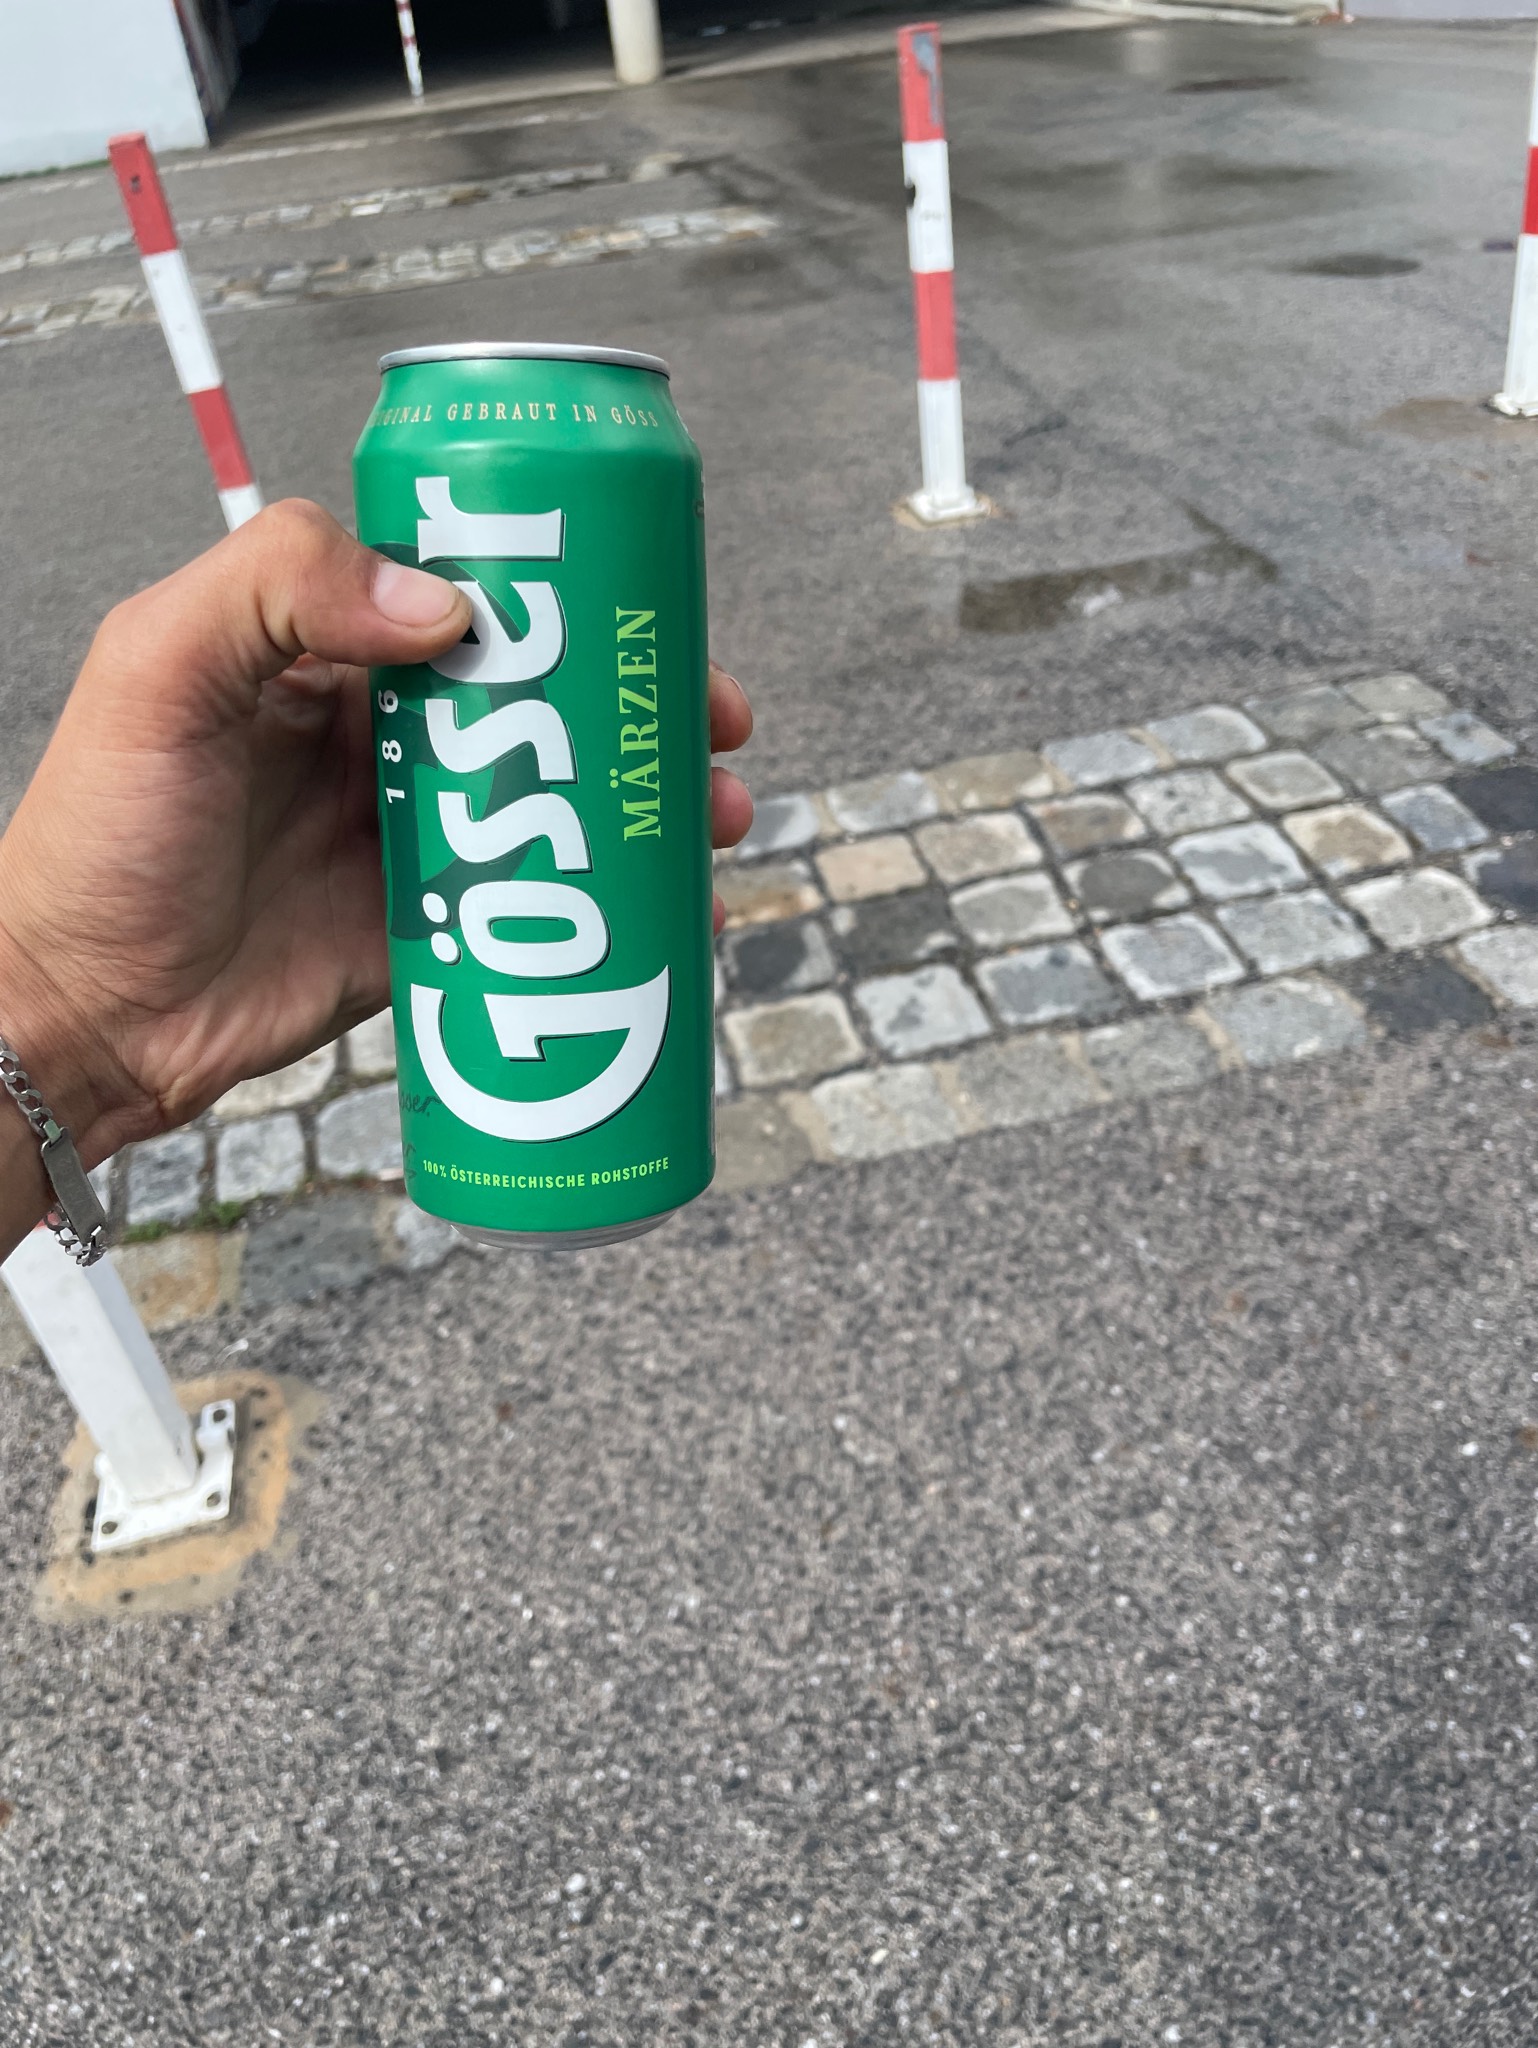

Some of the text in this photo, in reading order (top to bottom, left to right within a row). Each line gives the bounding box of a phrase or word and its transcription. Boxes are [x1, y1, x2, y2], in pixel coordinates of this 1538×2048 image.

[447, 402, 557, 421] GEBRAUT
[574, 403, 598, 422] IN
[611, 404, 659, 428] GÖSS
[377, 689, 406, 804] 186
[610, 606, 662, 841] MÄRZEN
[411, 475, 672, 1143] Gösser
[423, 1159, 447, 1178] 100%
[450, 1164, 585, 1190] ÖSTERREICHISCHE
[591, 1156, 669, 1185] ROHSTOFFE
